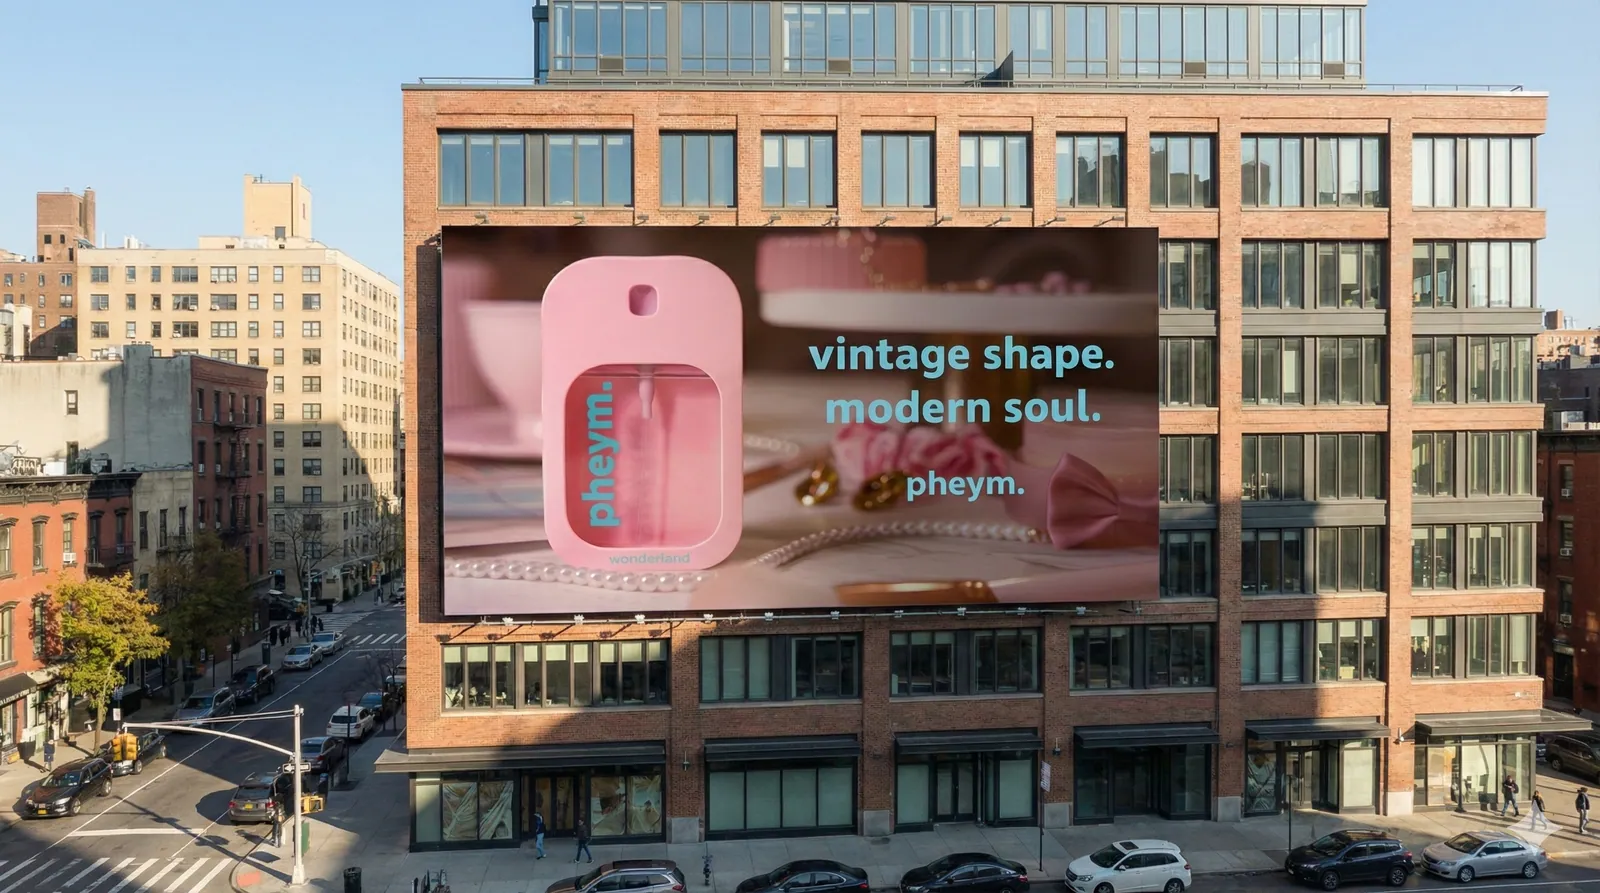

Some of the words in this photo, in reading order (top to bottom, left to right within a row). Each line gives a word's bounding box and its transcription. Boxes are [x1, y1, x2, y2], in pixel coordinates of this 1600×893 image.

[808, 335, 970, 379] vintage
[983, 335, 1115, 378] shape.
[826, 389, 991, 423] modern
[1003, 388, 1102, 422] soul.
[580, 381, 621, 527] pheym.
[906, 470, 1025, 502] pheym.
[609, 552, 691, 565] wonderland
